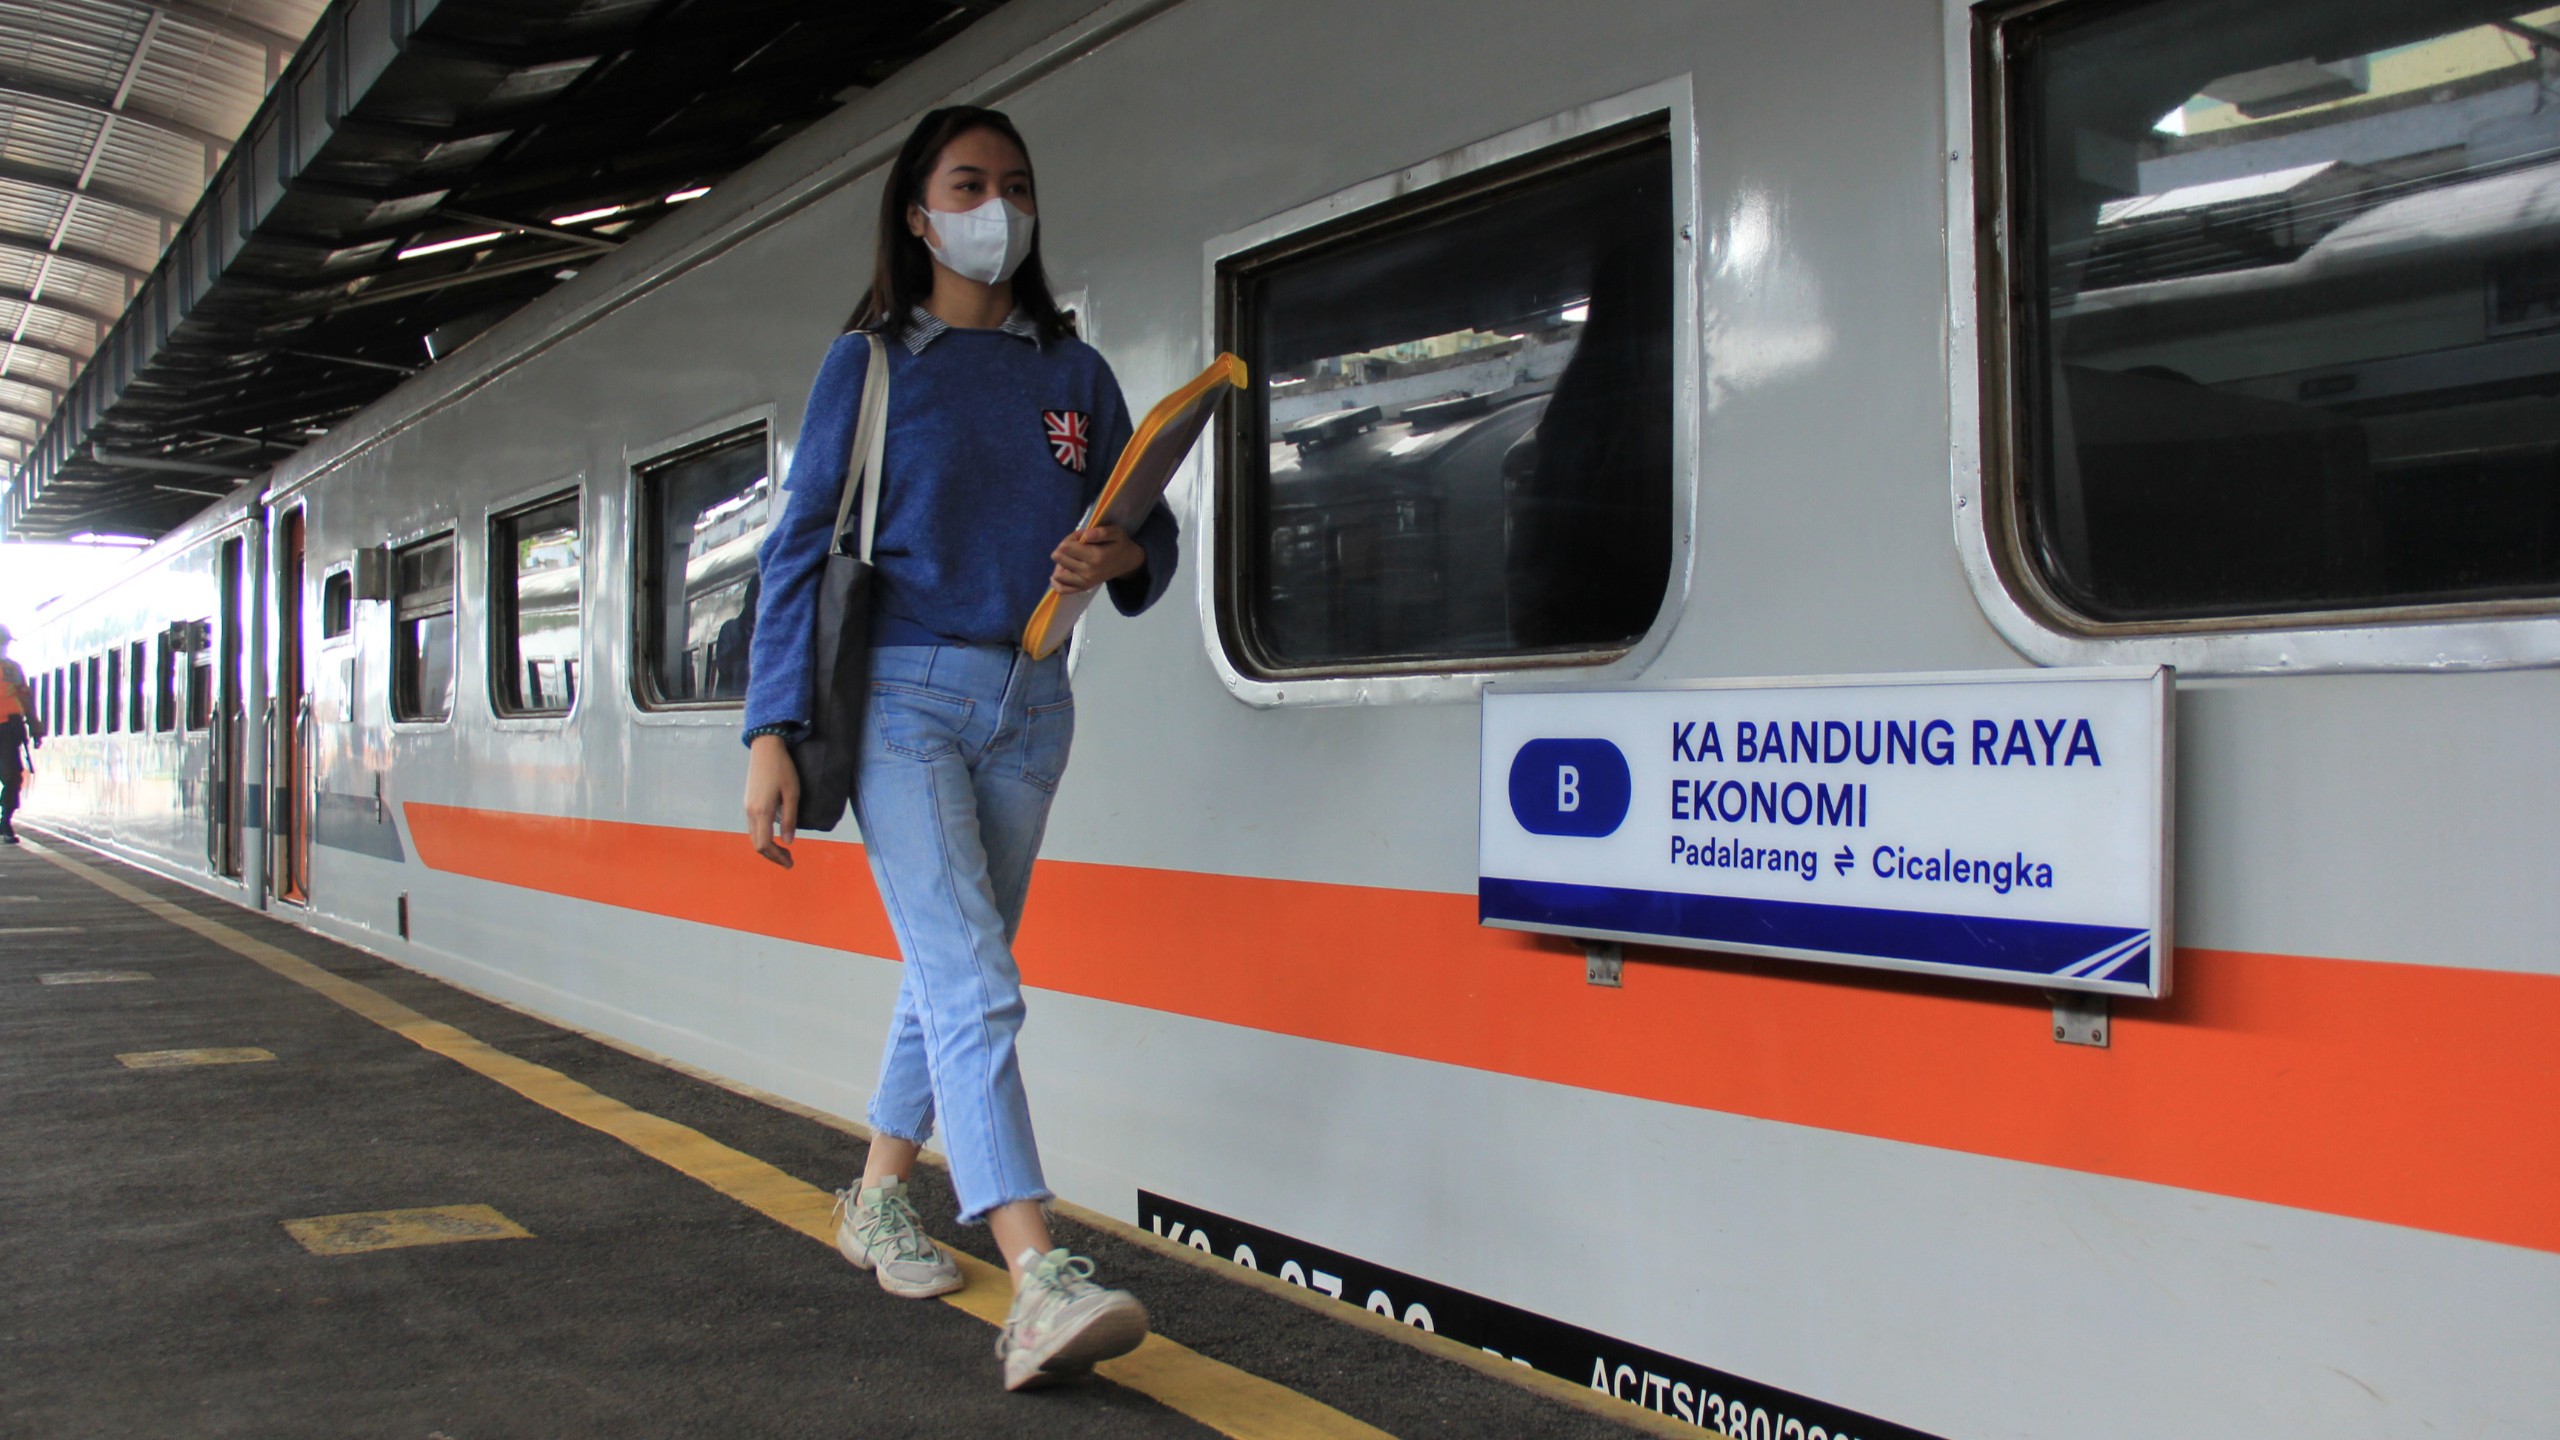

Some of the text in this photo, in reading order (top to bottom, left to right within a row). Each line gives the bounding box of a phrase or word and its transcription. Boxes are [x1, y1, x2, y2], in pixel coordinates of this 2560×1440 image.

[1672, 718, 2102, 767] KA BANDUNG RAYA
[1558, 765, 1580, 812] B
[1671, 779, 1867, 828] EKONOMI
[1671, 835, 2053, 895] Padalarang Cicalengka
